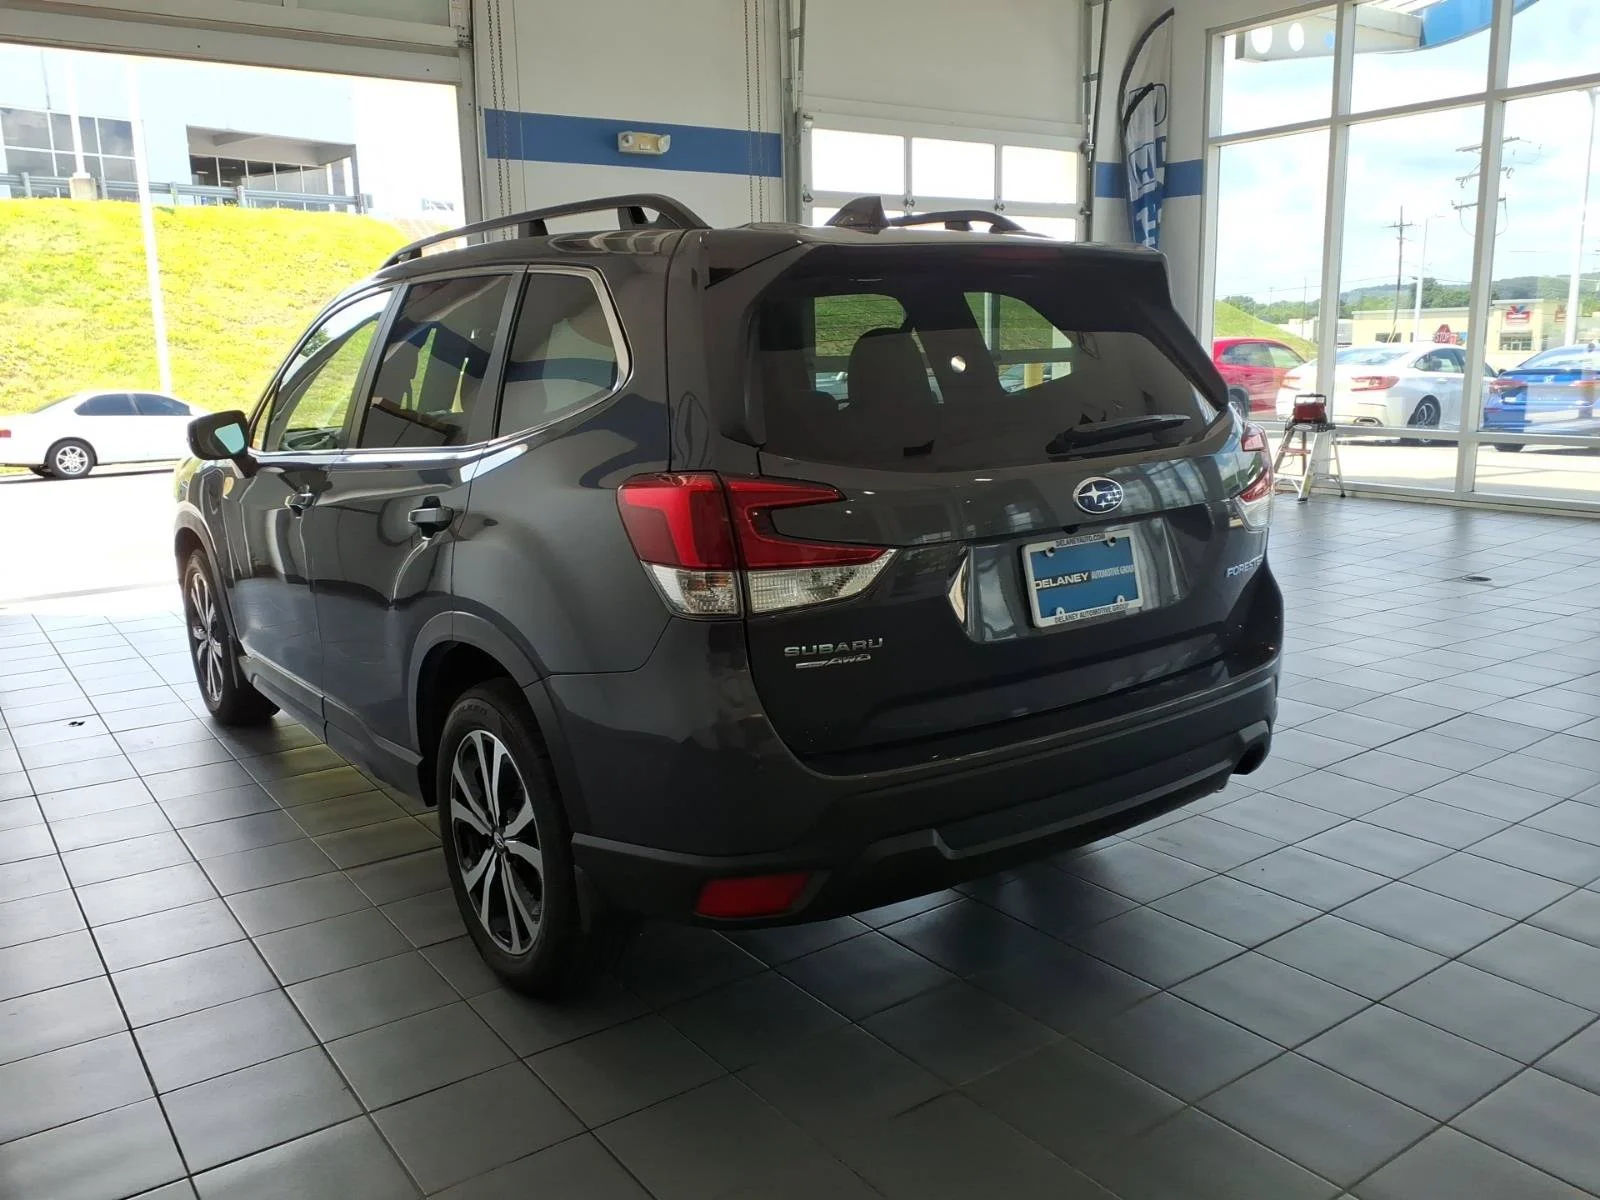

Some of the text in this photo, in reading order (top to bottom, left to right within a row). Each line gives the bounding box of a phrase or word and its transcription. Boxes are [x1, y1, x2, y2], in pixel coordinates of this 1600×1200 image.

[1434, 331, 1450, 343] STOP
[1034, 572, 1089, 589] DELANEY
[1091, 567, 1120, 579] AUTOMOTIVE
[1055, 603, 1128, 624] DELANEY AUTOMOTIVE GROUP
[784, 638, 883, 656] SUBARU
